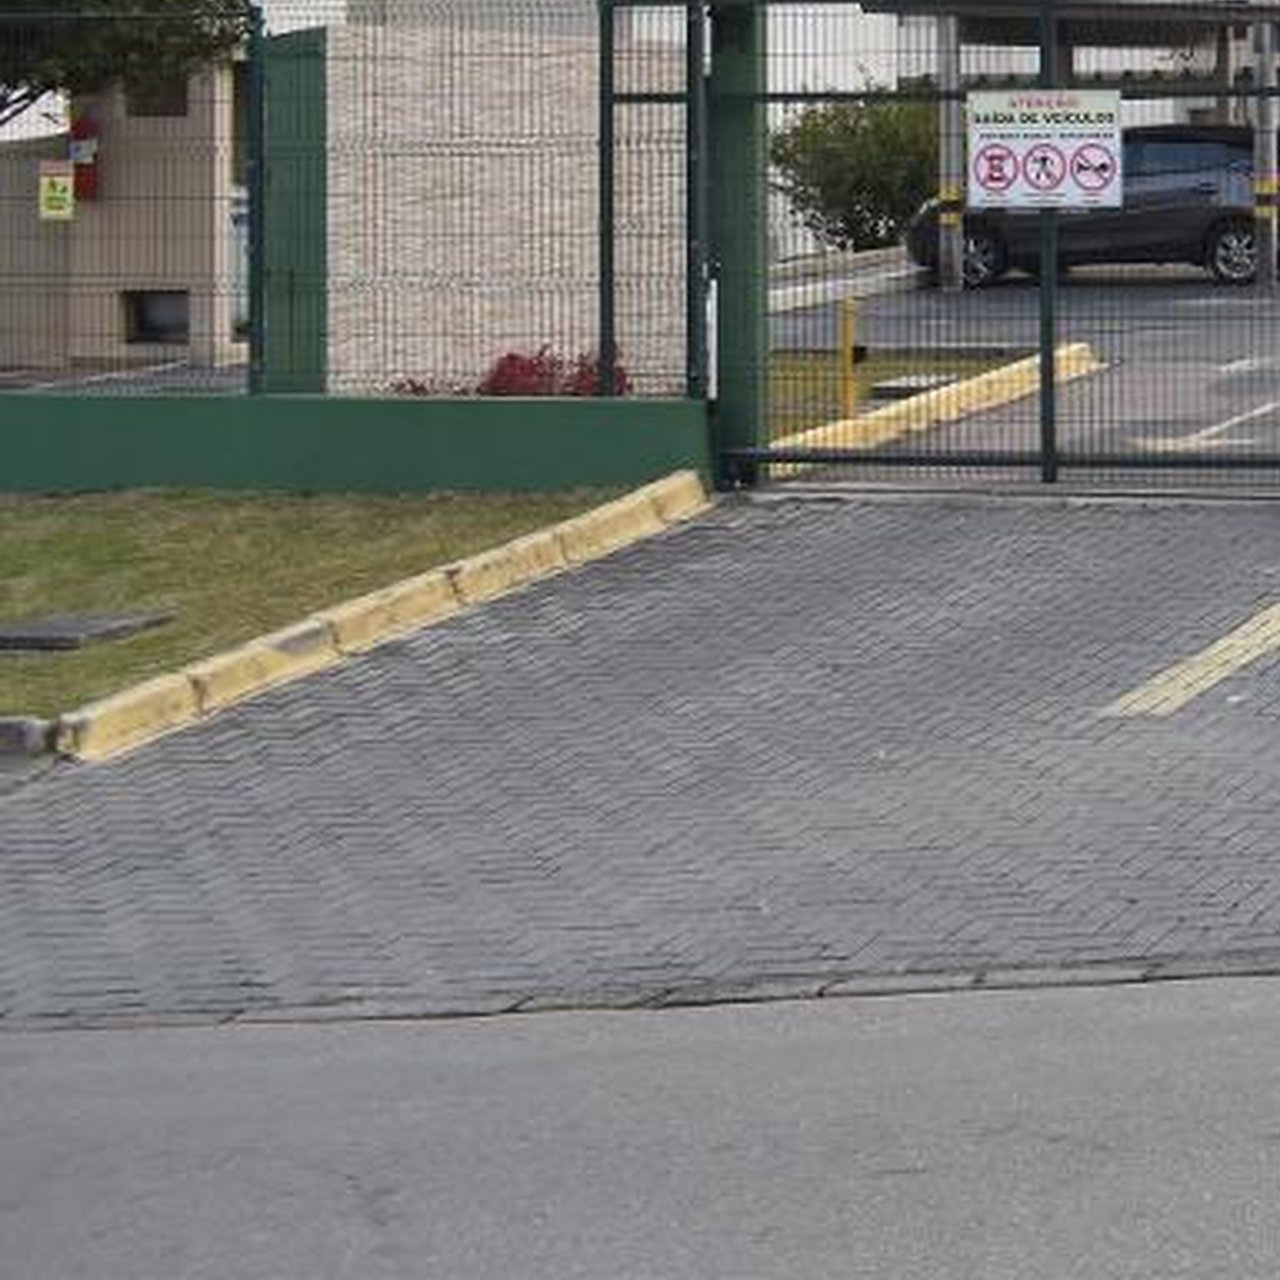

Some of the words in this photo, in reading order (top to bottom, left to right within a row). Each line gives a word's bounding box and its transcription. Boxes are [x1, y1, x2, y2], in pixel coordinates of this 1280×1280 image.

[974, 110, 1015, 124] SAÍDA
[1020, 112, 1039, 124] DE
[1043, 110, 1114, 124] VEÍCULOS
